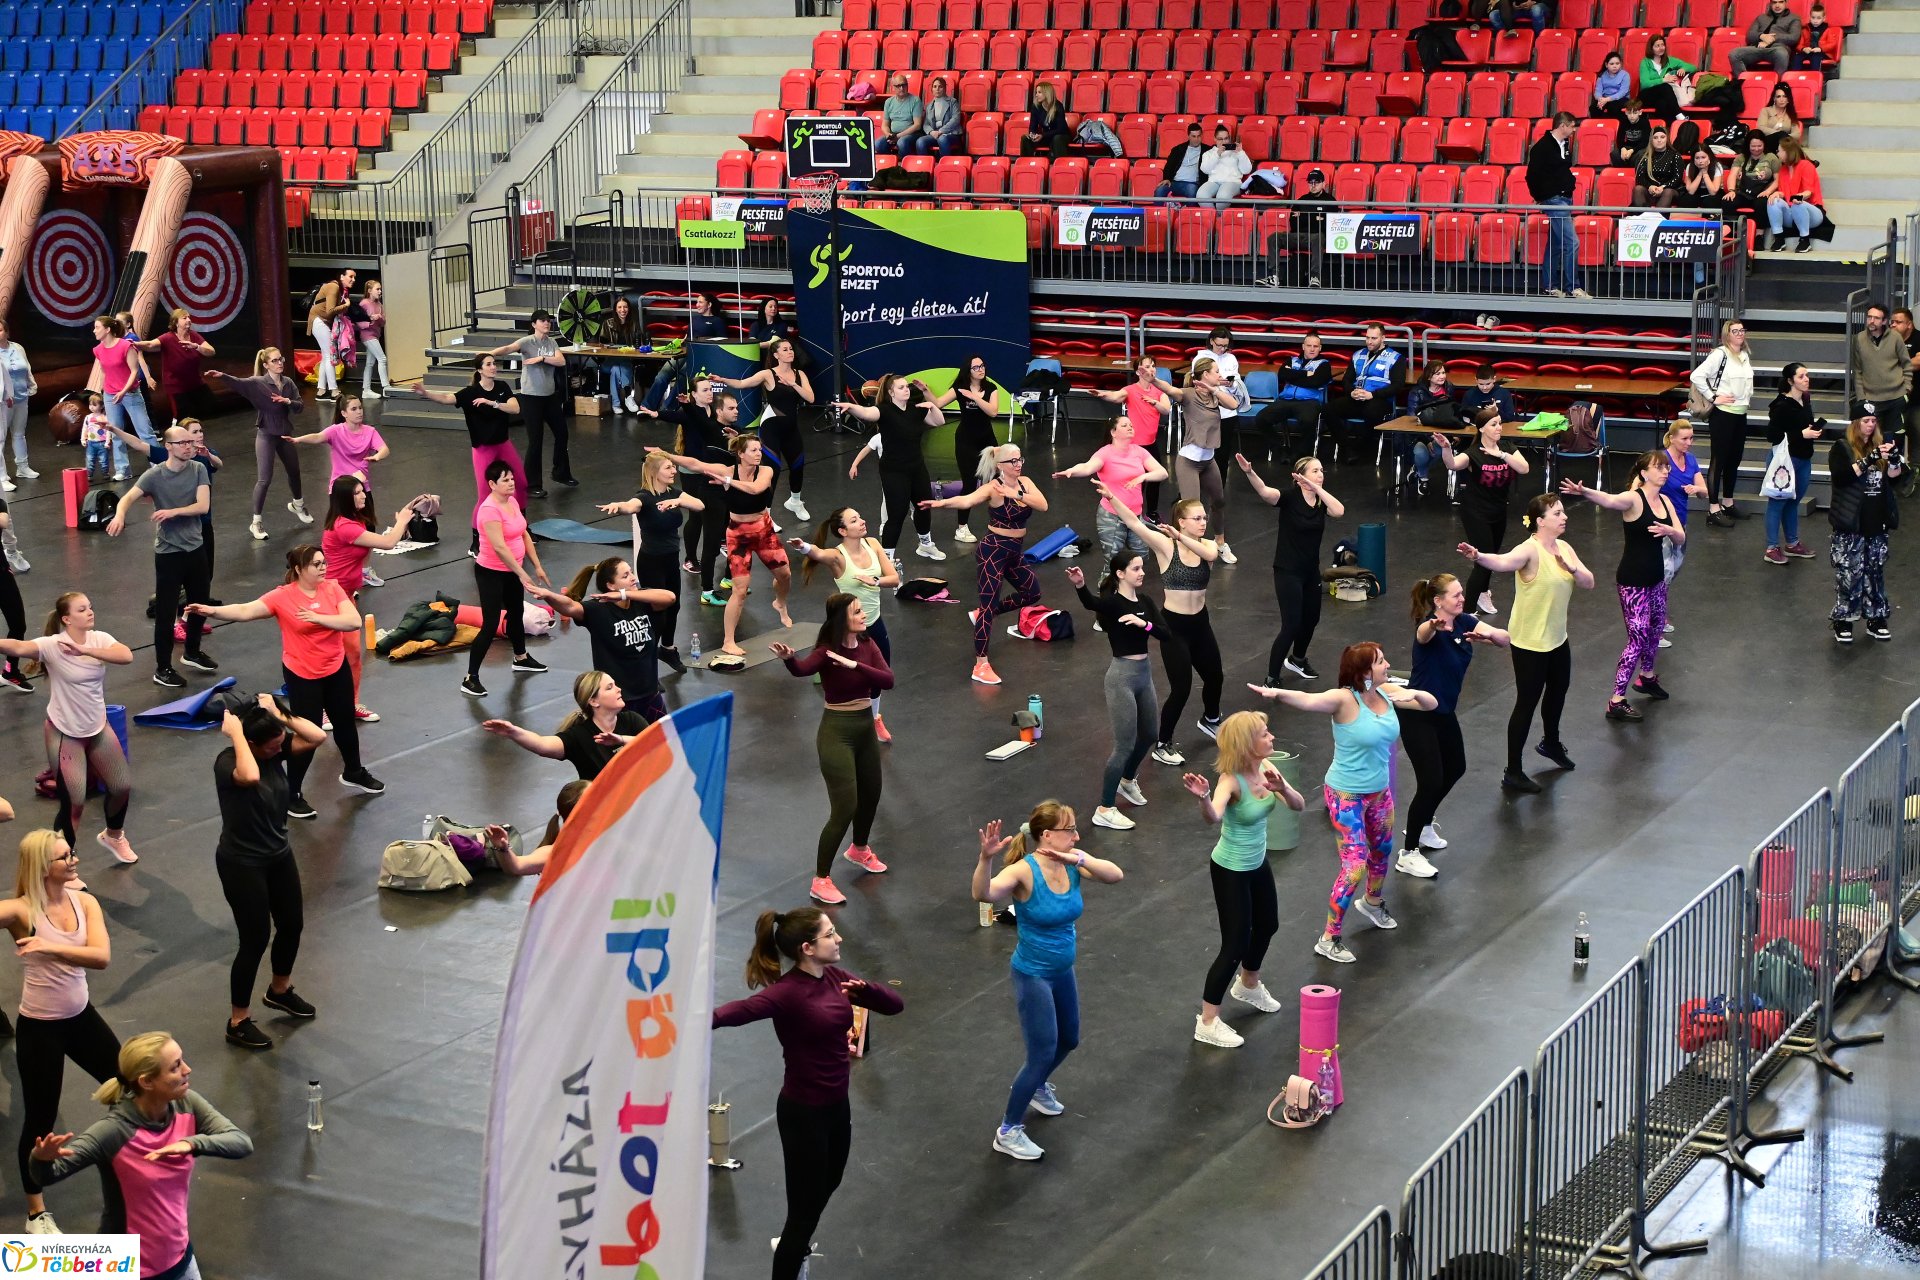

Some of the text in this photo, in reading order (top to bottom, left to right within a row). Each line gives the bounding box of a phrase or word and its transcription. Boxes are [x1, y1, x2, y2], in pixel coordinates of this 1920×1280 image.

[74, 143, 137, 173] AXE
[82, 175, 132, 183] THROWING
[741, 207, 784, 220] PECSÉTELŐ
[1091, 216, 1140, 230] PECSÉTELŐ
[684, 229, 737, 239] Csatlakozz!
[1068, 231, 1077, 240] 18
[1362, 223, 1415, 237] PECSÉTELŐ
[1336, 238, 1345, 248] 13
[1657, 229, 1715, 245] PECSÉTELŐ
[1629, 246, 1639, 256] 14
[841, 263, 905, 277] SPORTOLÓ
[840, 279, 879, 290] EMZET
[841, 291, 989, 329] port egy életen át!
[1481, 463, 1509, 471] READY
[624, 628, 652, 647] ROCK
[606, 892, 678, 1059] ad!
